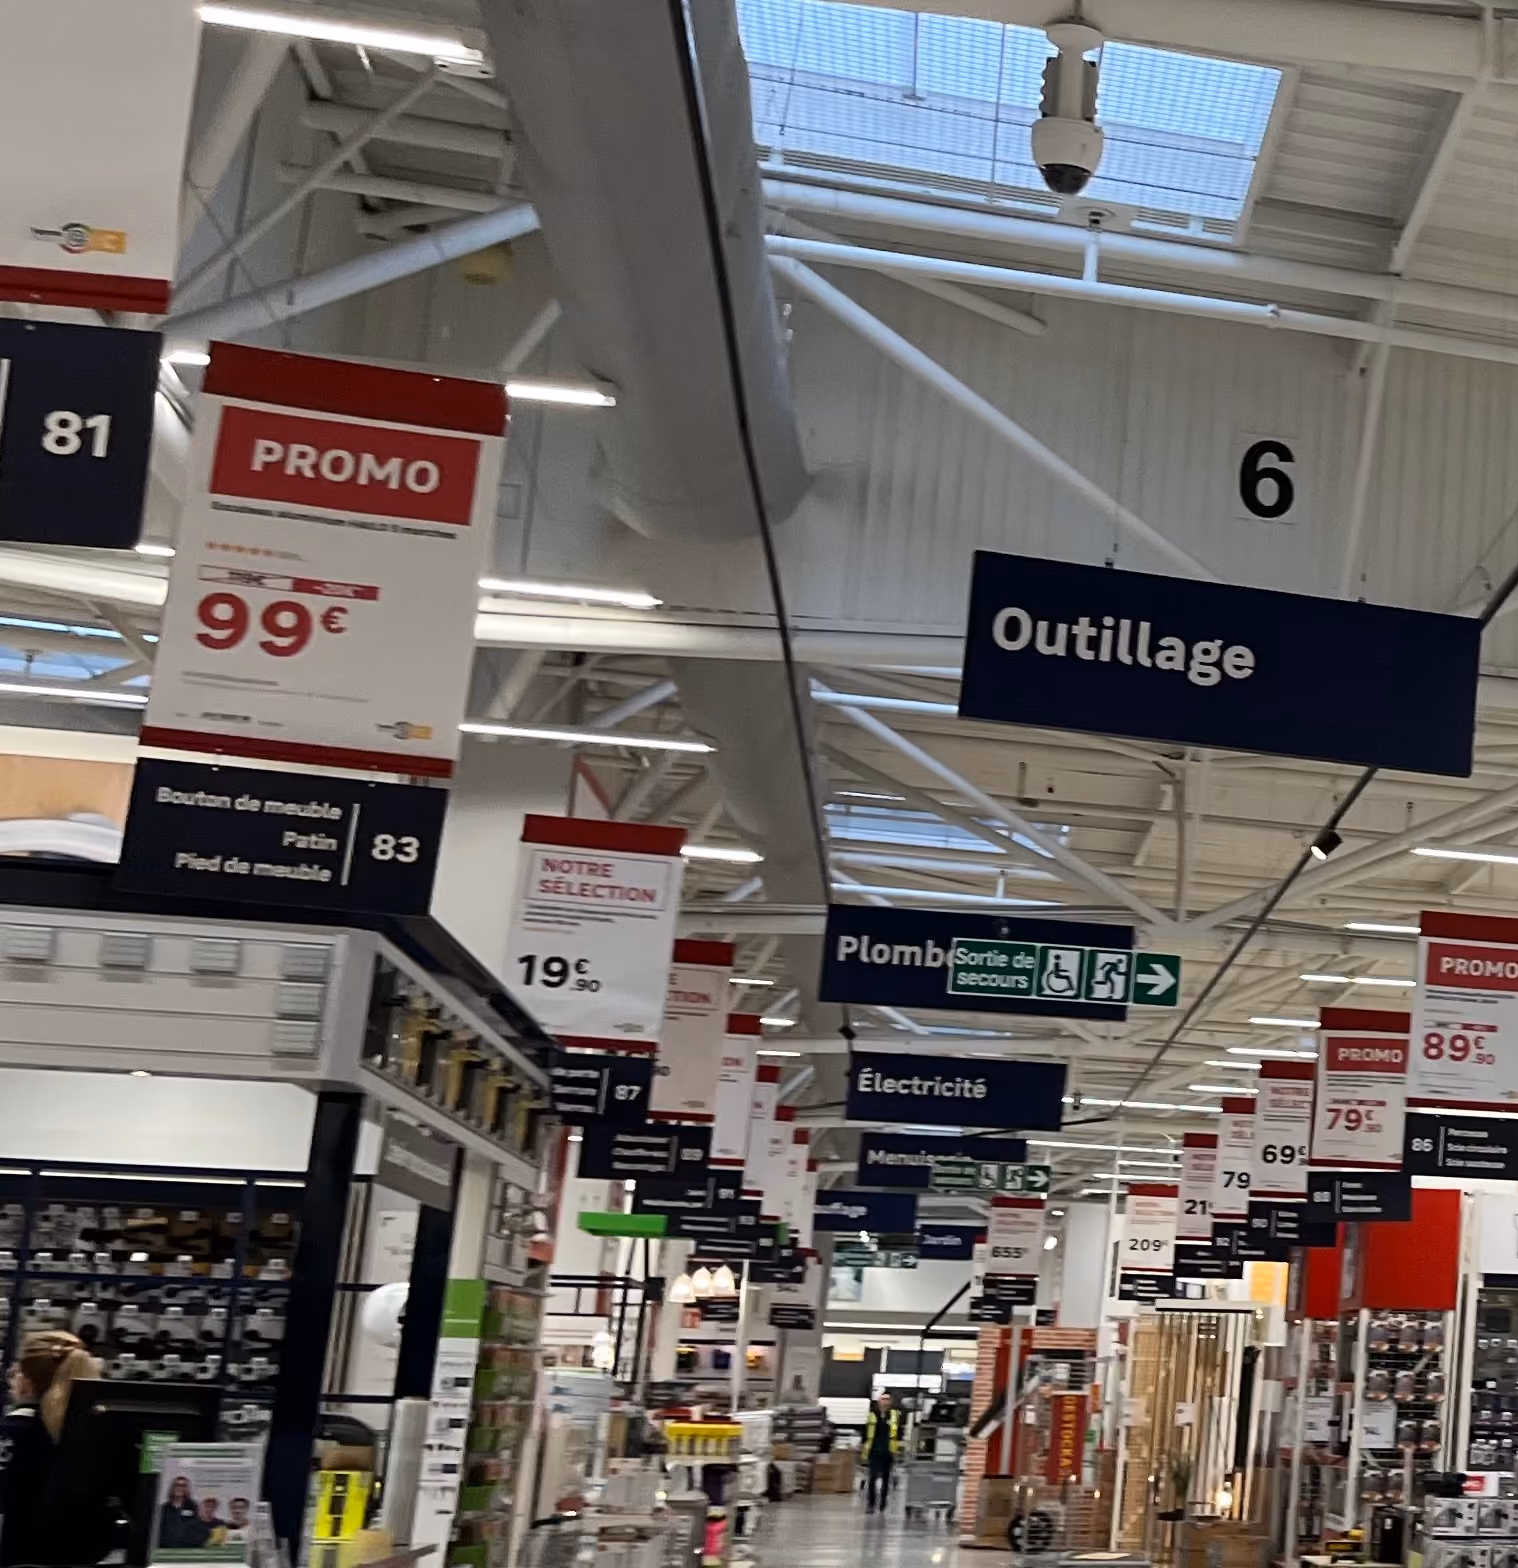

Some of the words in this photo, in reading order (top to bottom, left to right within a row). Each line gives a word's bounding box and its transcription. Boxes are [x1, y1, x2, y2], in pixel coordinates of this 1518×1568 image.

[41, 410, 112, 458] 81
[250, 438, 441, 494] PROMO
[1239, 439, 1296, 519] 6
[991, 605, 1257, 687] Outillage
[233, 793, 261, 812] de
[370, 833, 421, 863] 83
[223, 856, 250, 875] de
[541, 858, 615, 879] NOTRE
[538, 875, 657, 903] SÉLECTION
[836, 935, 953, 969] Plomb
[954, 948, 1008, 969] Sortie
[1012, 950, 1035, 970] de
[956, 973, 1031, 990] secours
[614, 1085, 642, 1101] 87
[857, 1067, 988, 1100] Électricité
